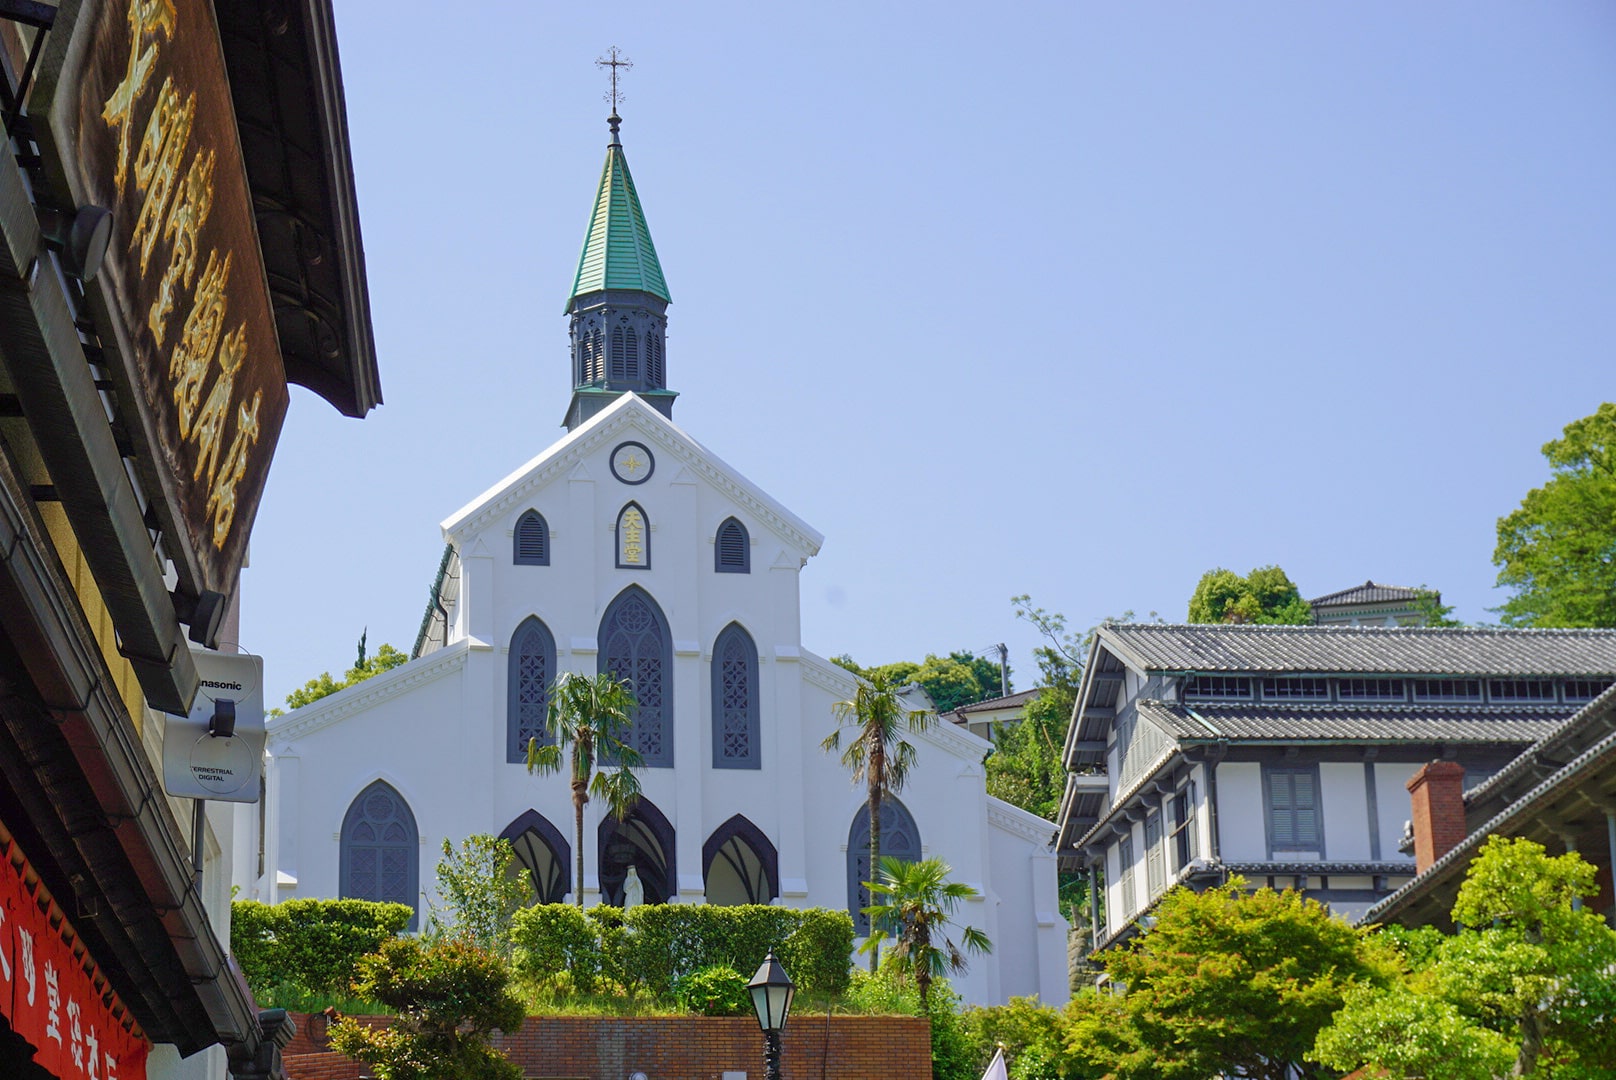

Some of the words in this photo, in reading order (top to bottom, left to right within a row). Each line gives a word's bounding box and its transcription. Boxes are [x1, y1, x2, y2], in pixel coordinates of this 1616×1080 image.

[622, 511, 643, 563] 天主堂
[199, 680, 242, 691] nasonic
[198, 774, 225, 782] DIGITAL
